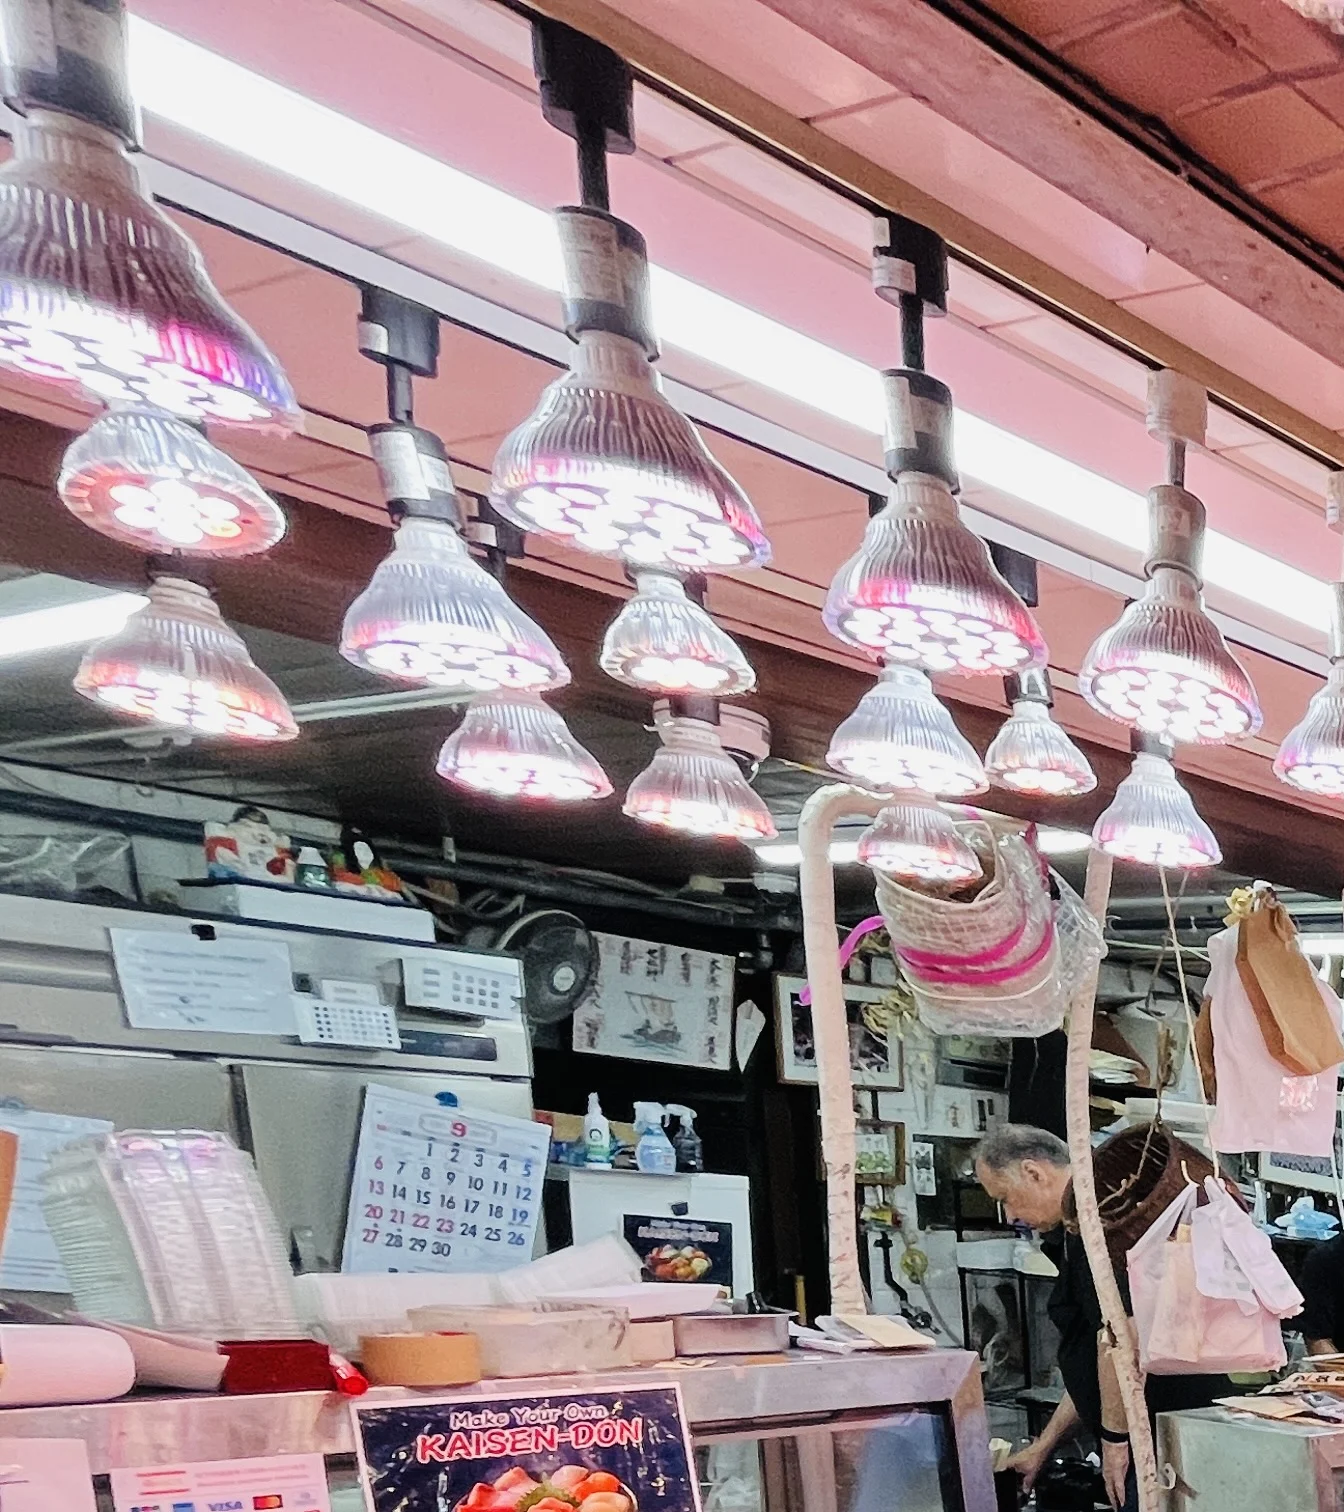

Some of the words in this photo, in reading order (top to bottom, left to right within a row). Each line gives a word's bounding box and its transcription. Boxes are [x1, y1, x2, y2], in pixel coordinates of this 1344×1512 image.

[451, 1122, 467, 1138] 9
[374, 1155, 384, 1170] 6
[396, 1160, 407, 1175] 7
[421, 1166, 431, 1181] 8
[446, 1171, 456, 1186] 9
[468, 1175, 484, 1191] 10
[492, 1180, 508, 1196] 11
[515, 1184, 532, 1201] 12
[427, 1143, 433, 1157] 1
[450, 1148, 460, 1163] 2
[474, 1153, 484, 1168] 3
[497, 1159, 508, 1174] 4
[522, 1163, 532, 1178] 5
[368, 1178, 385, 1196] 13
[391, 1184, 407, 1201] 14
[416, 1189, 431, 1205] 15
[440, 1194, 456, 1210] 16
[463, 1199, 480, 1214] 17
[488, 1203, 504, 1219] 18
[511, 1208, 529, 1224] 19
[361, 1227, 380, 1244] 27
[385, 1232, 403, 1248] 28
[408, 1236, 427, 1253] 29
[431, 1241, 451, 1257] 30
[364, 1203, 384, 1220] 20
[389, 1208, 405, 1225] 21
[411, 1213, 430, 1229] 22
[436, 1217, 455, 1234] 23
[460, 1222, 478, 1238] 24
[484, 1227, 502, 1242] 25
[507, 1231, 526, 1247] 26
[449, 1408, 510, 1430] Make
[511, 1404, 563, 1427] Your
[562, 1402, 609, 1420] Own
[415, 1415, 646, 1465] KAISEN-DON
[207, 1500, 244, 1512] VISA
